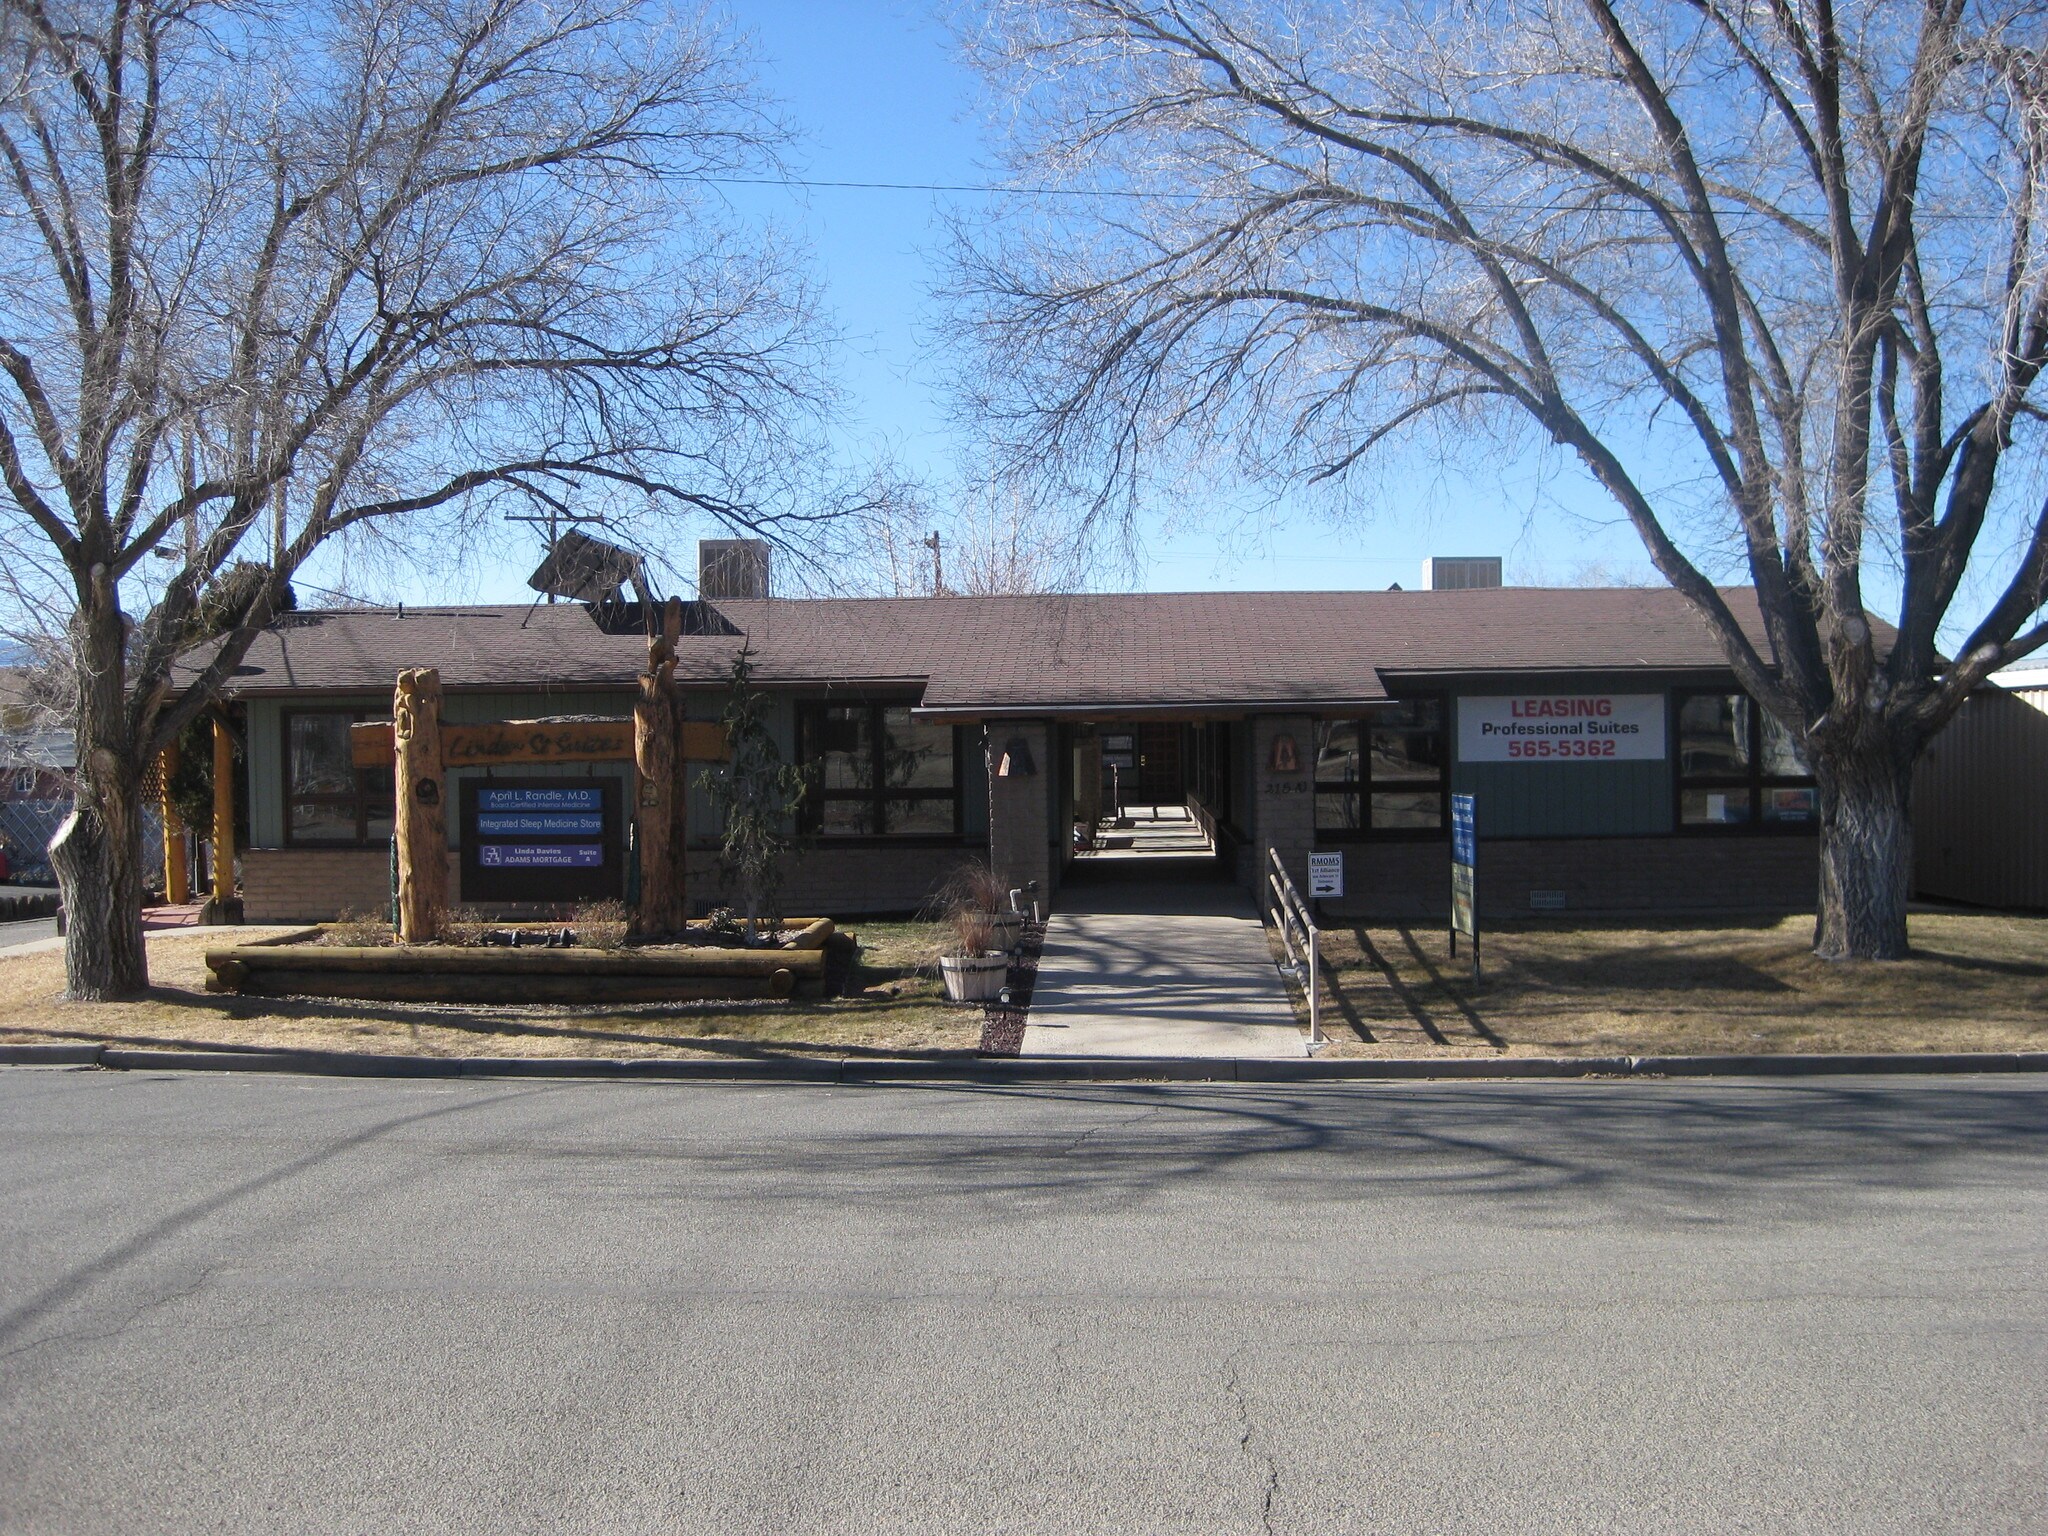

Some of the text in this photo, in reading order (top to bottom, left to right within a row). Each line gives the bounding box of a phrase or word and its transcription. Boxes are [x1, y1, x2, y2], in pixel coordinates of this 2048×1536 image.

[1511, 698, 1612, 718] LEASING
[1481, 720, 1639, 736] Professional Suites
[1508, 739, 1616, 758] 565-5362
[490, 791, 592, 802] April L. Randle, M.D.
[480, 819, 601, 830] Integrated Sleep Medicine Store
[1311, 857, 1340, 865] RMOMS
